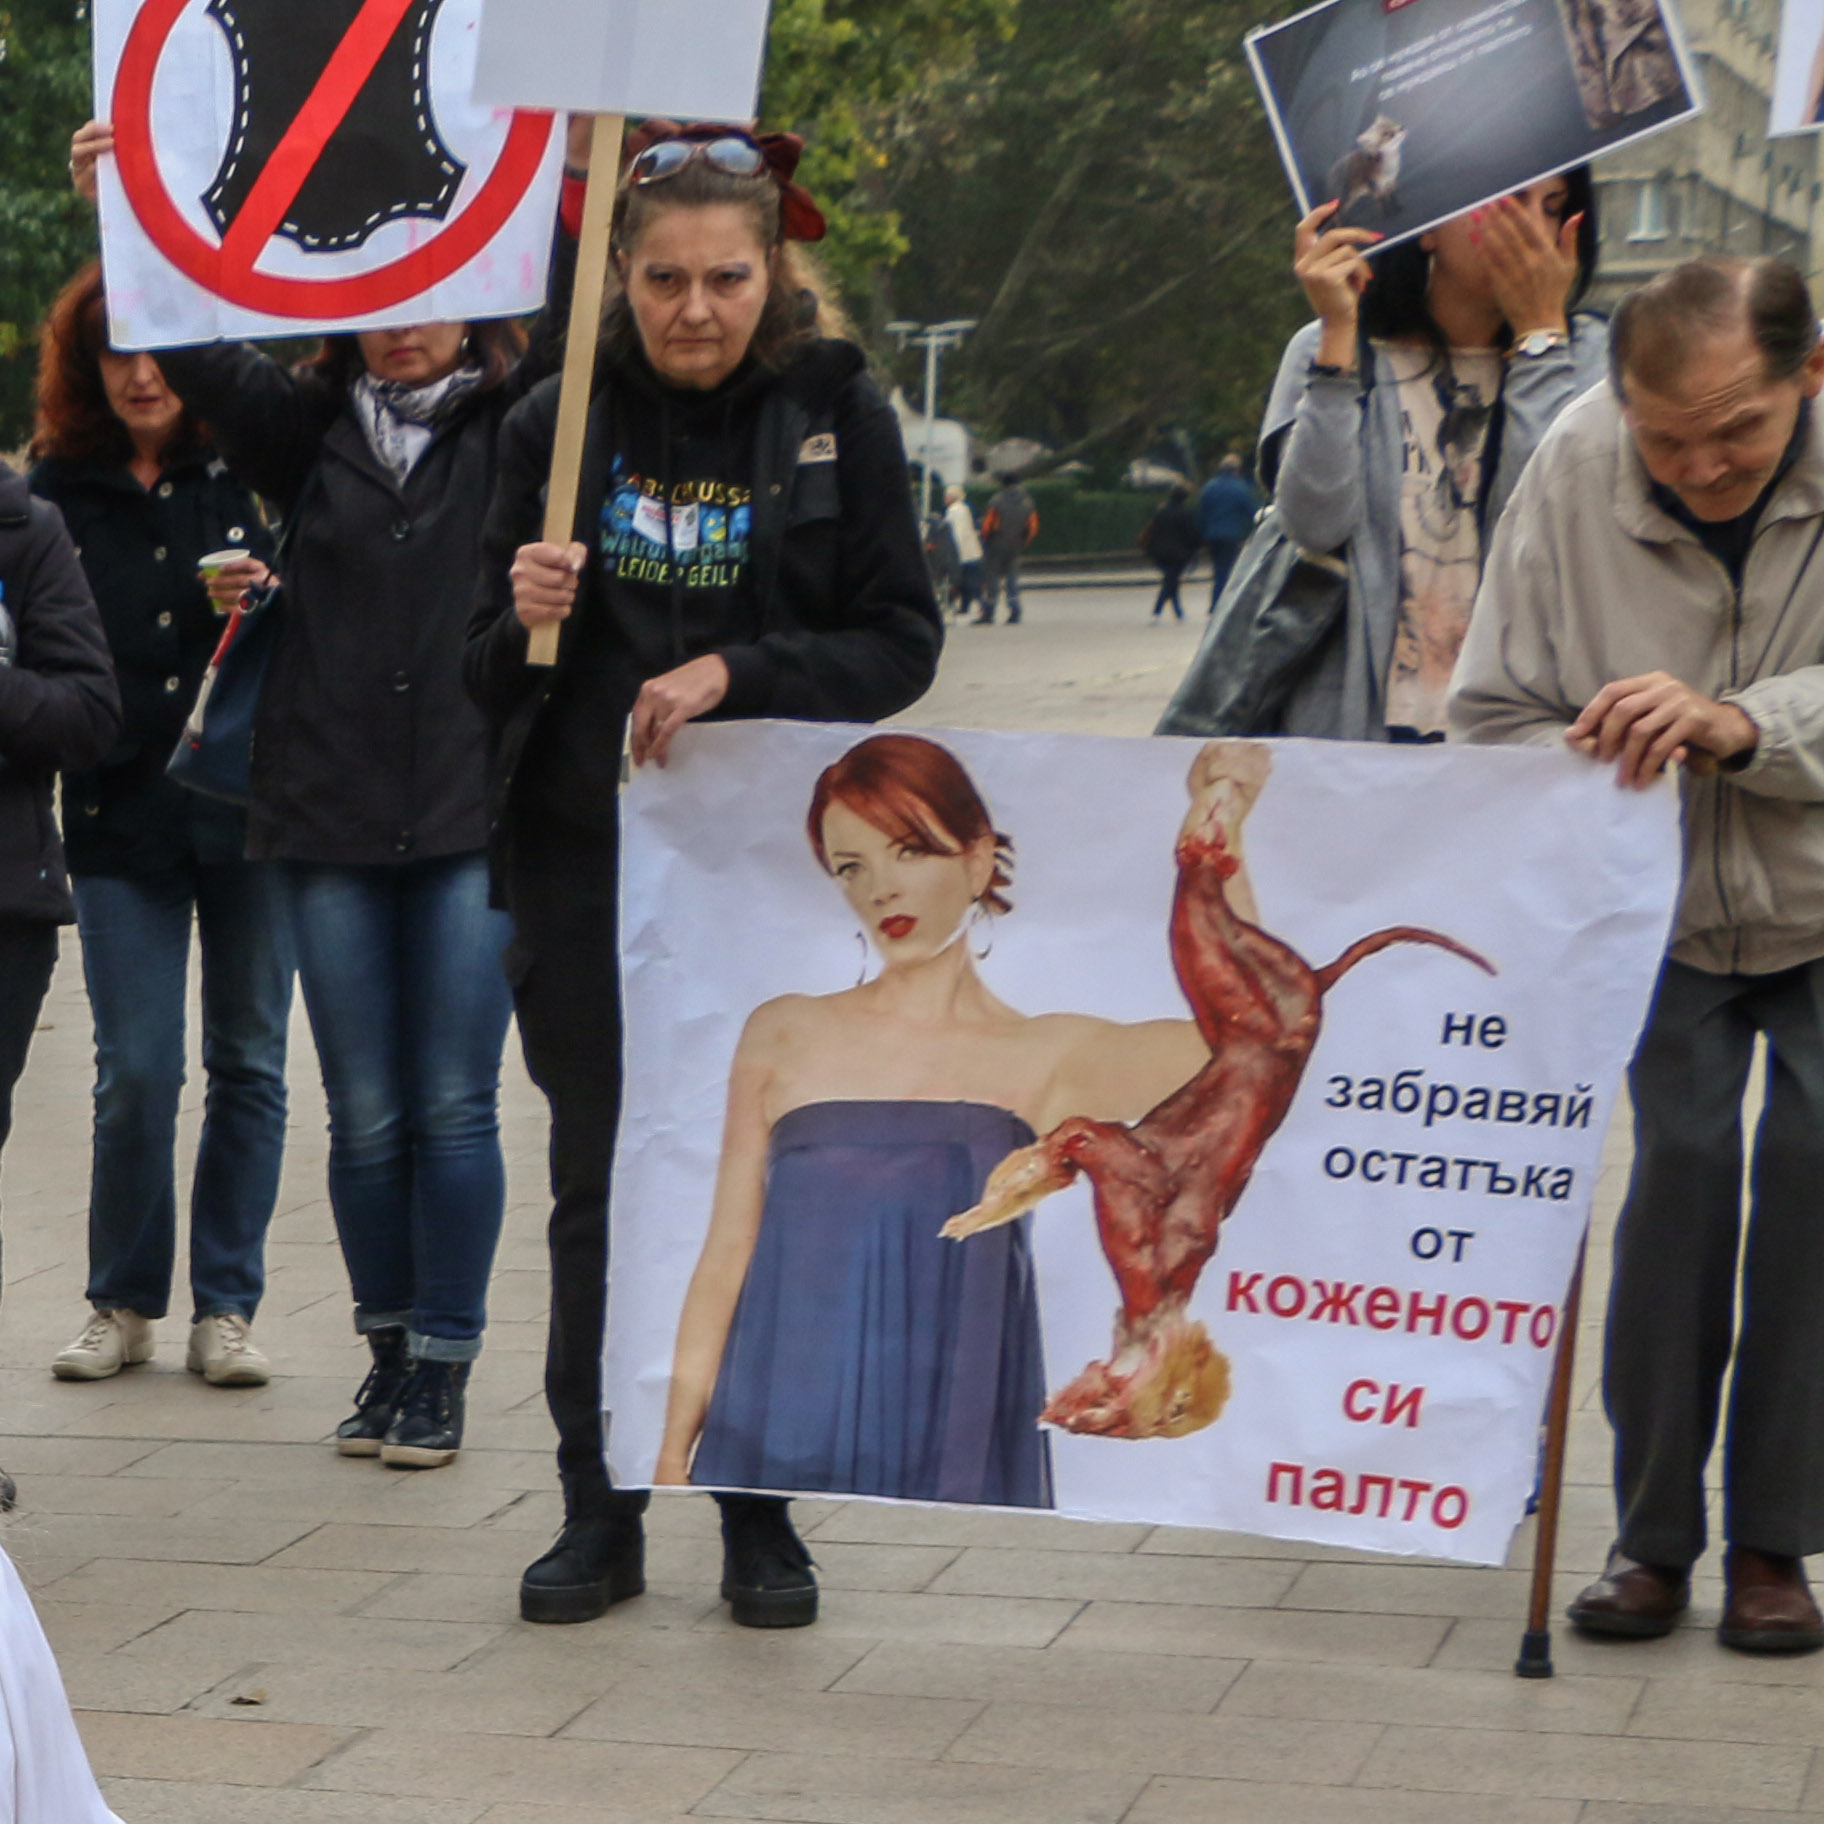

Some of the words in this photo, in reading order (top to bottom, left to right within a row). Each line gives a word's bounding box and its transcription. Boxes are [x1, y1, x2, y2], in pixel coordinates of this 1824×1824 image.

[616, 556, 685, 585] LEIDE
[1440, 1012, 1508, 1049] не
[1325, 1069, 1594, 1128] забравяй
[1323, 1145, 1575, 1200] остатъка
[1410, 1226, 1475, 1262] от
[1225, 1270, 1557, 1348] коженото
[1342, 1378, 1425, 1428] си
[1265, 1461, 1471, 1529] палто
